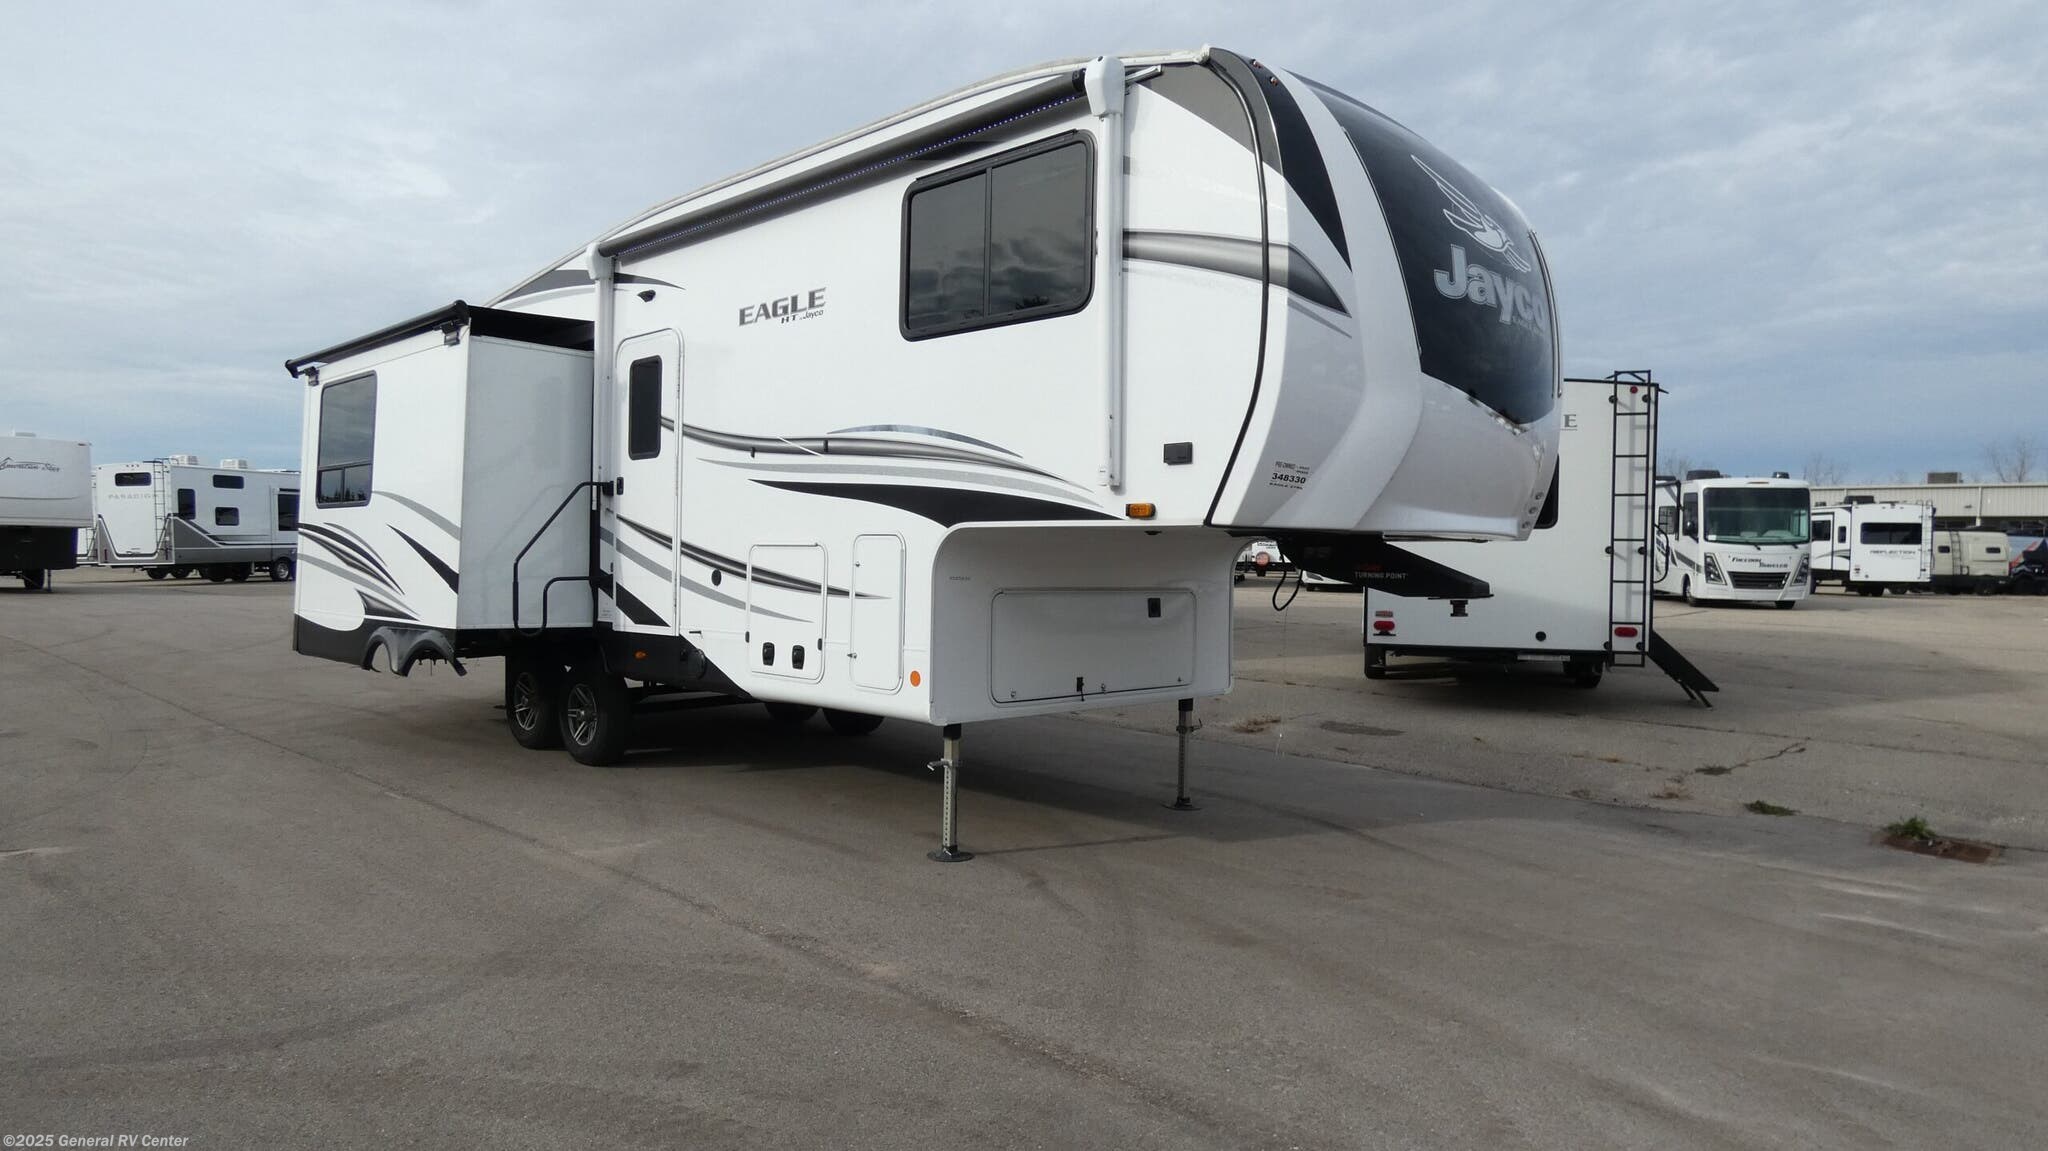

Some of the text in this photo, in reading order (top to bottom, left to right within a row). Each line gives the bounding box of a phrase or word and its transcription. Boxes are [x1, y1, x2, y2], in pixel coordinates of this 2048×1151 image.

[1434, 243, 1548, 331] Jayco
[739, 286, 826, 326] EAGLE
[780, 314, 800, 324] HT
[1272, 472, 1307, 484] 348330
